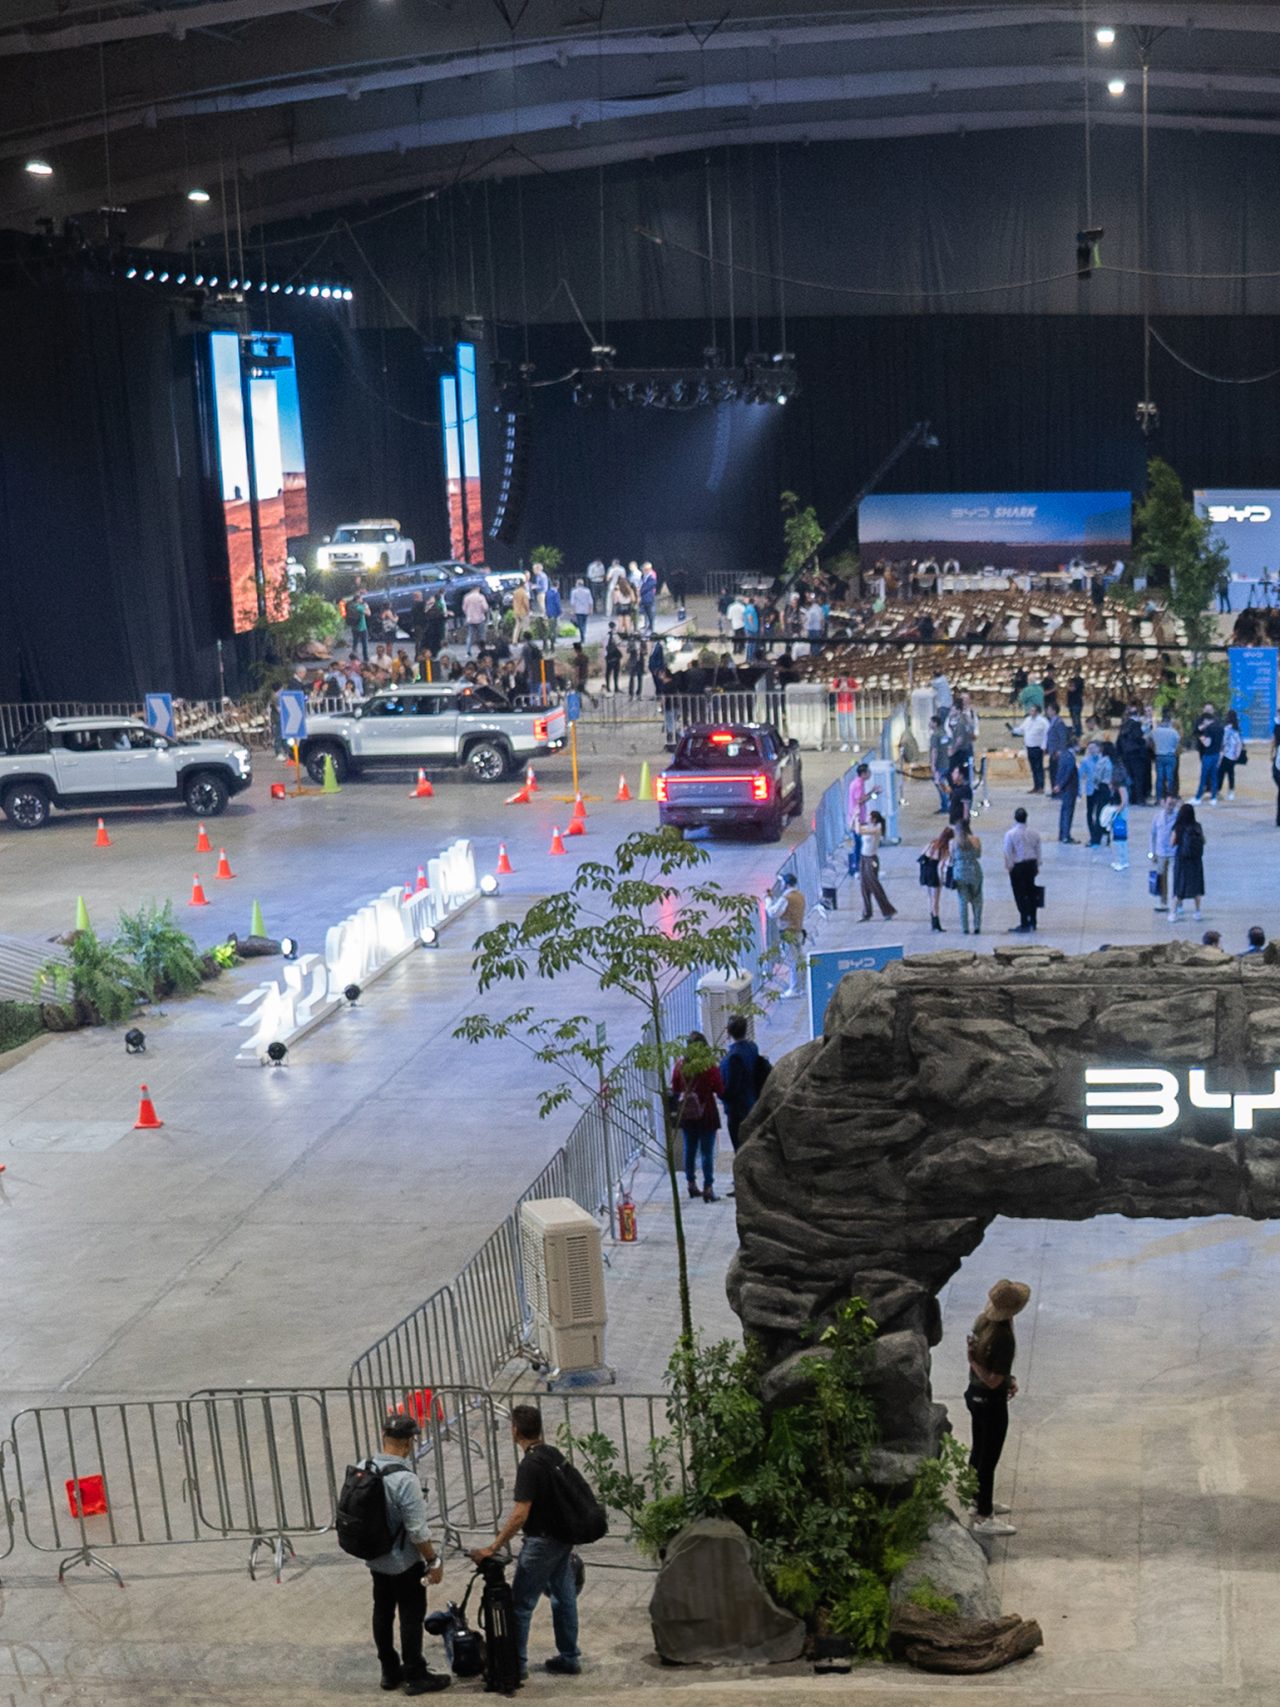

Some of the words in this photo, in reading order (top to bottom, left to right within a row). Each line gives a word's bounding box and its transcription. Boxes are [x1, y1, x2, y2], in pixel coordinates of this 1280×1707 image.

[951, 508, 990, 518] BYD
[994, 506, 1037, 518] SHARK
[1207, 505, 1271, 522] BYD
[837, 957, 876, 970] BYD
